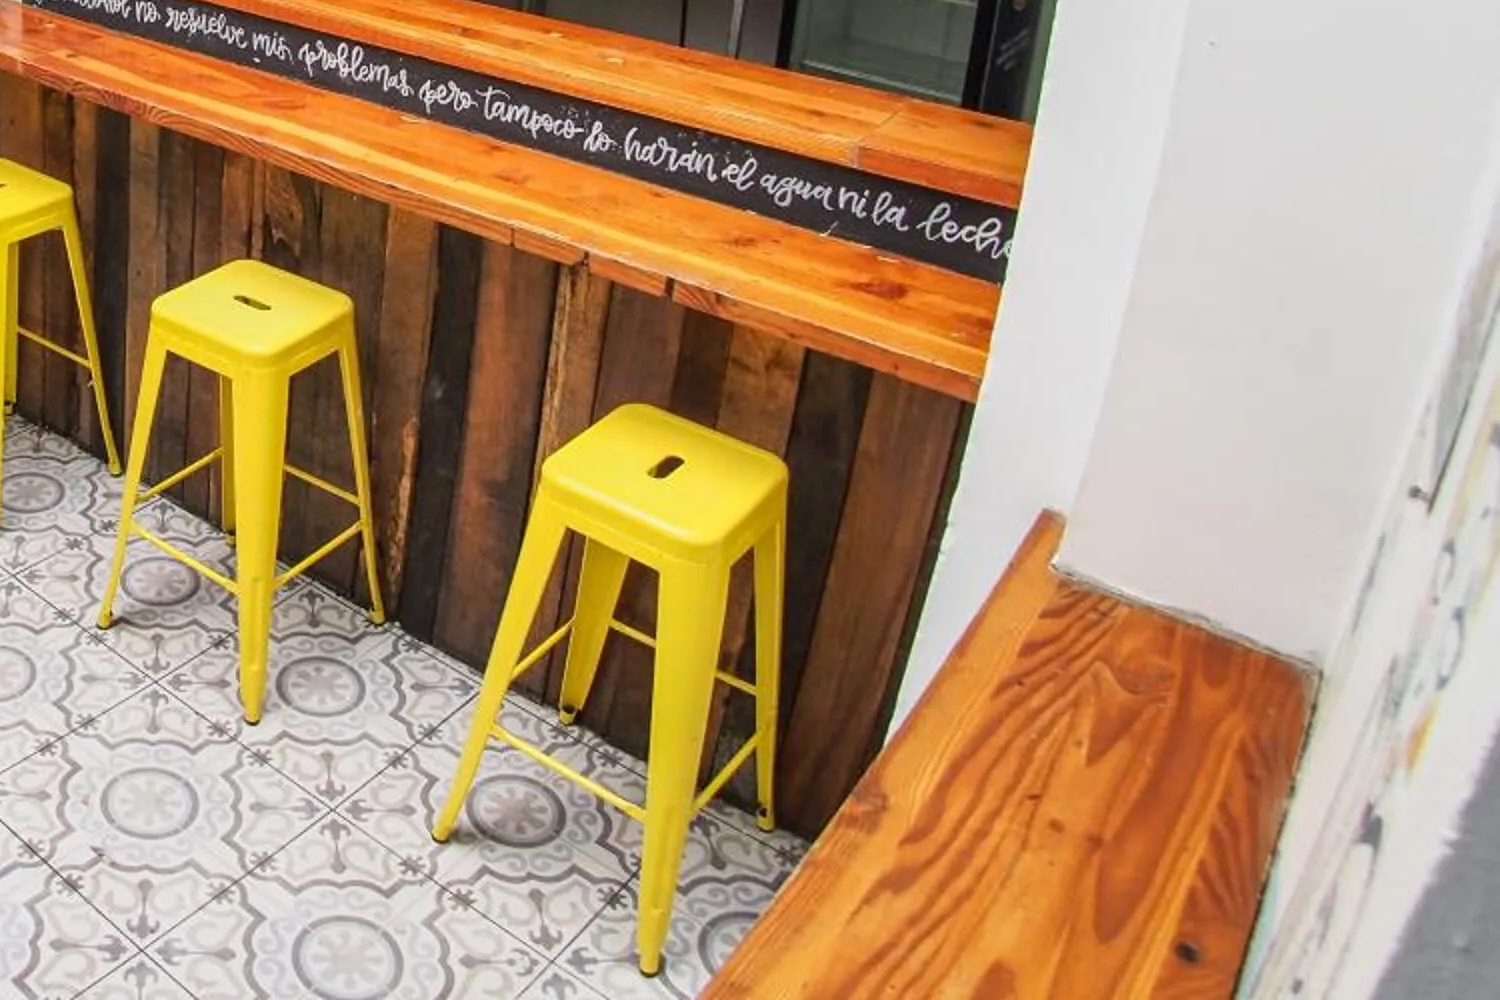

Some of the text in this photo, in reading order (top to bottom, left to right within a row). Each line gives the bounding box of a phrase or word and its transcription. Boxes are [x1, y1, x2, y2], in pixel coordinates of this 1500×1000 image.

[135, 0, 161, 23] no
[165, 7, 248, 49] resuelve
[252, 31, 293, 63] mis
[297, 40, 414, 98] problemas
[419, 79, 478, 114] pero
[476, 85, 584, 139] tampoco
[722, 156, 759, 191] el
[759, 171, 834, 210] agua
[838, 186, 867, 218] ni
[873, 191, 909, 232] la
